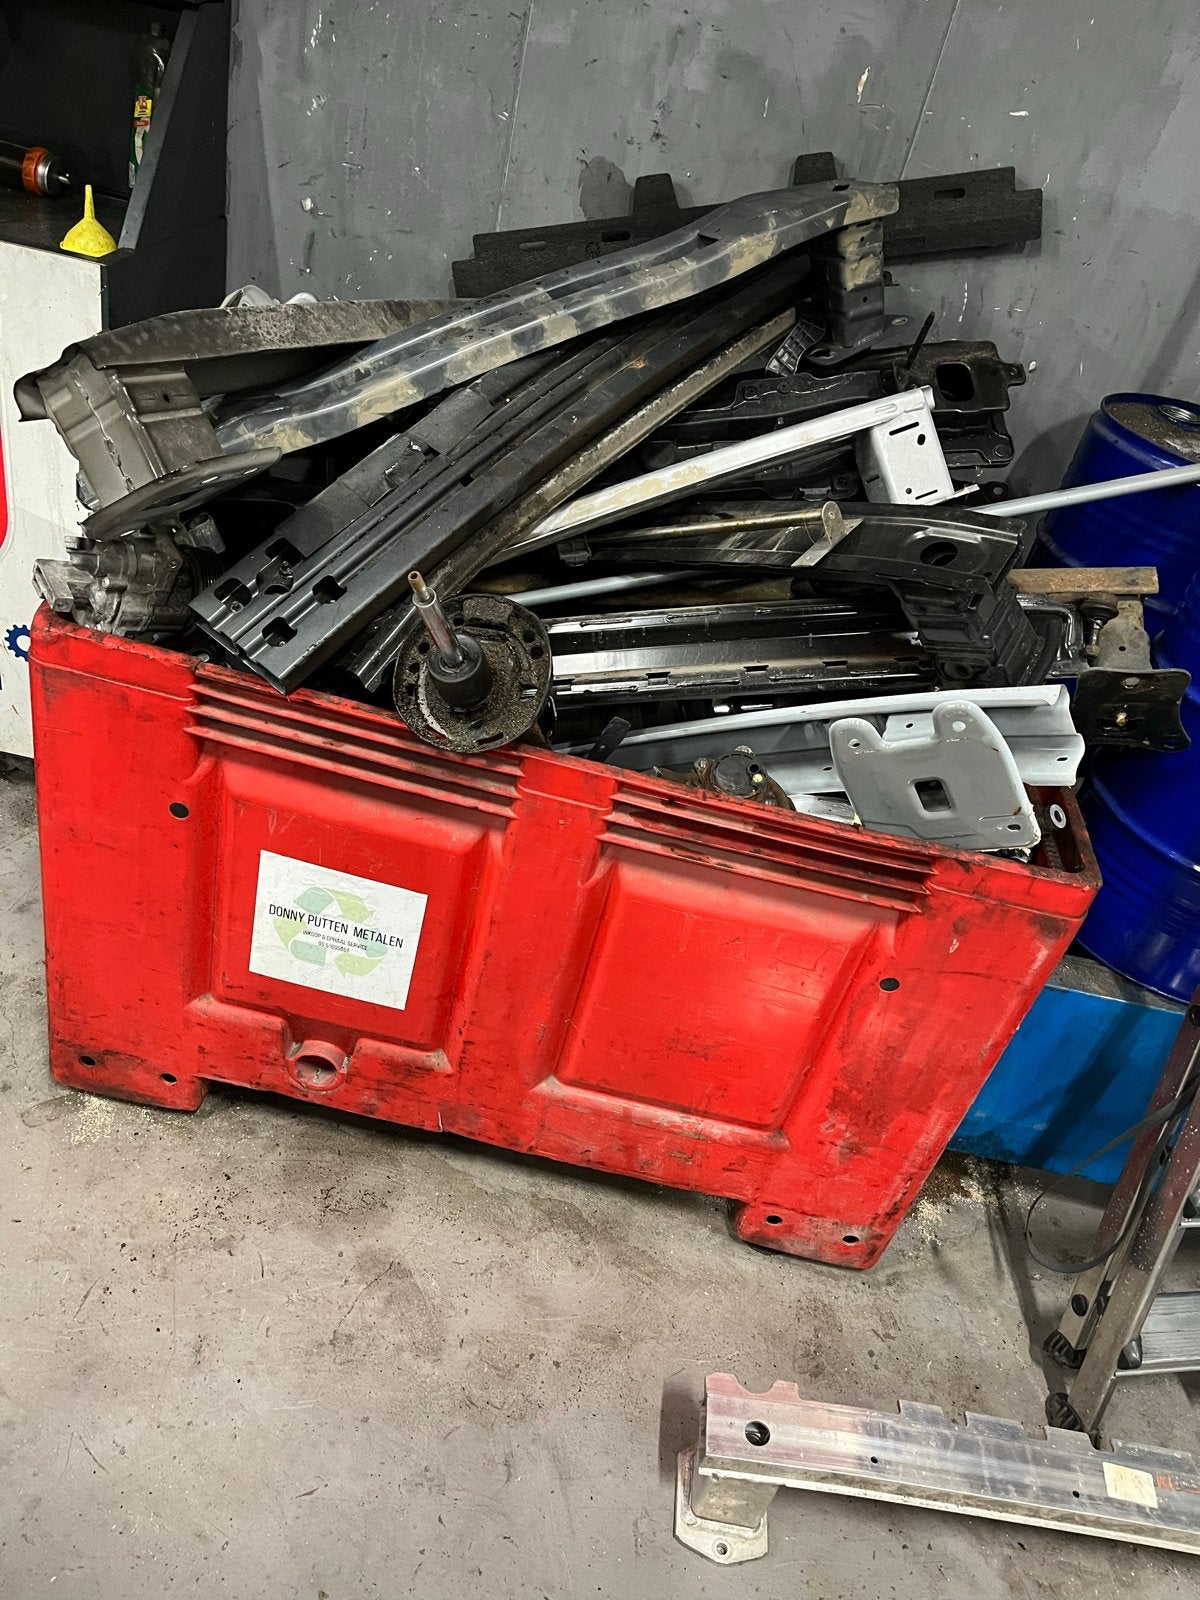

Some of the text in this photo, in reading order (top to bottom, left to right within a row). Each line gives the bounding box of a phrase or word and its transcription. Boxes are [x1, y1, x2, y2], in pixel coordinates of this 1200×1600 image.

[269, 903, 404, 949] DONNY PUTTEN METALEN
[346, 941, 368, 951] SERVICE
